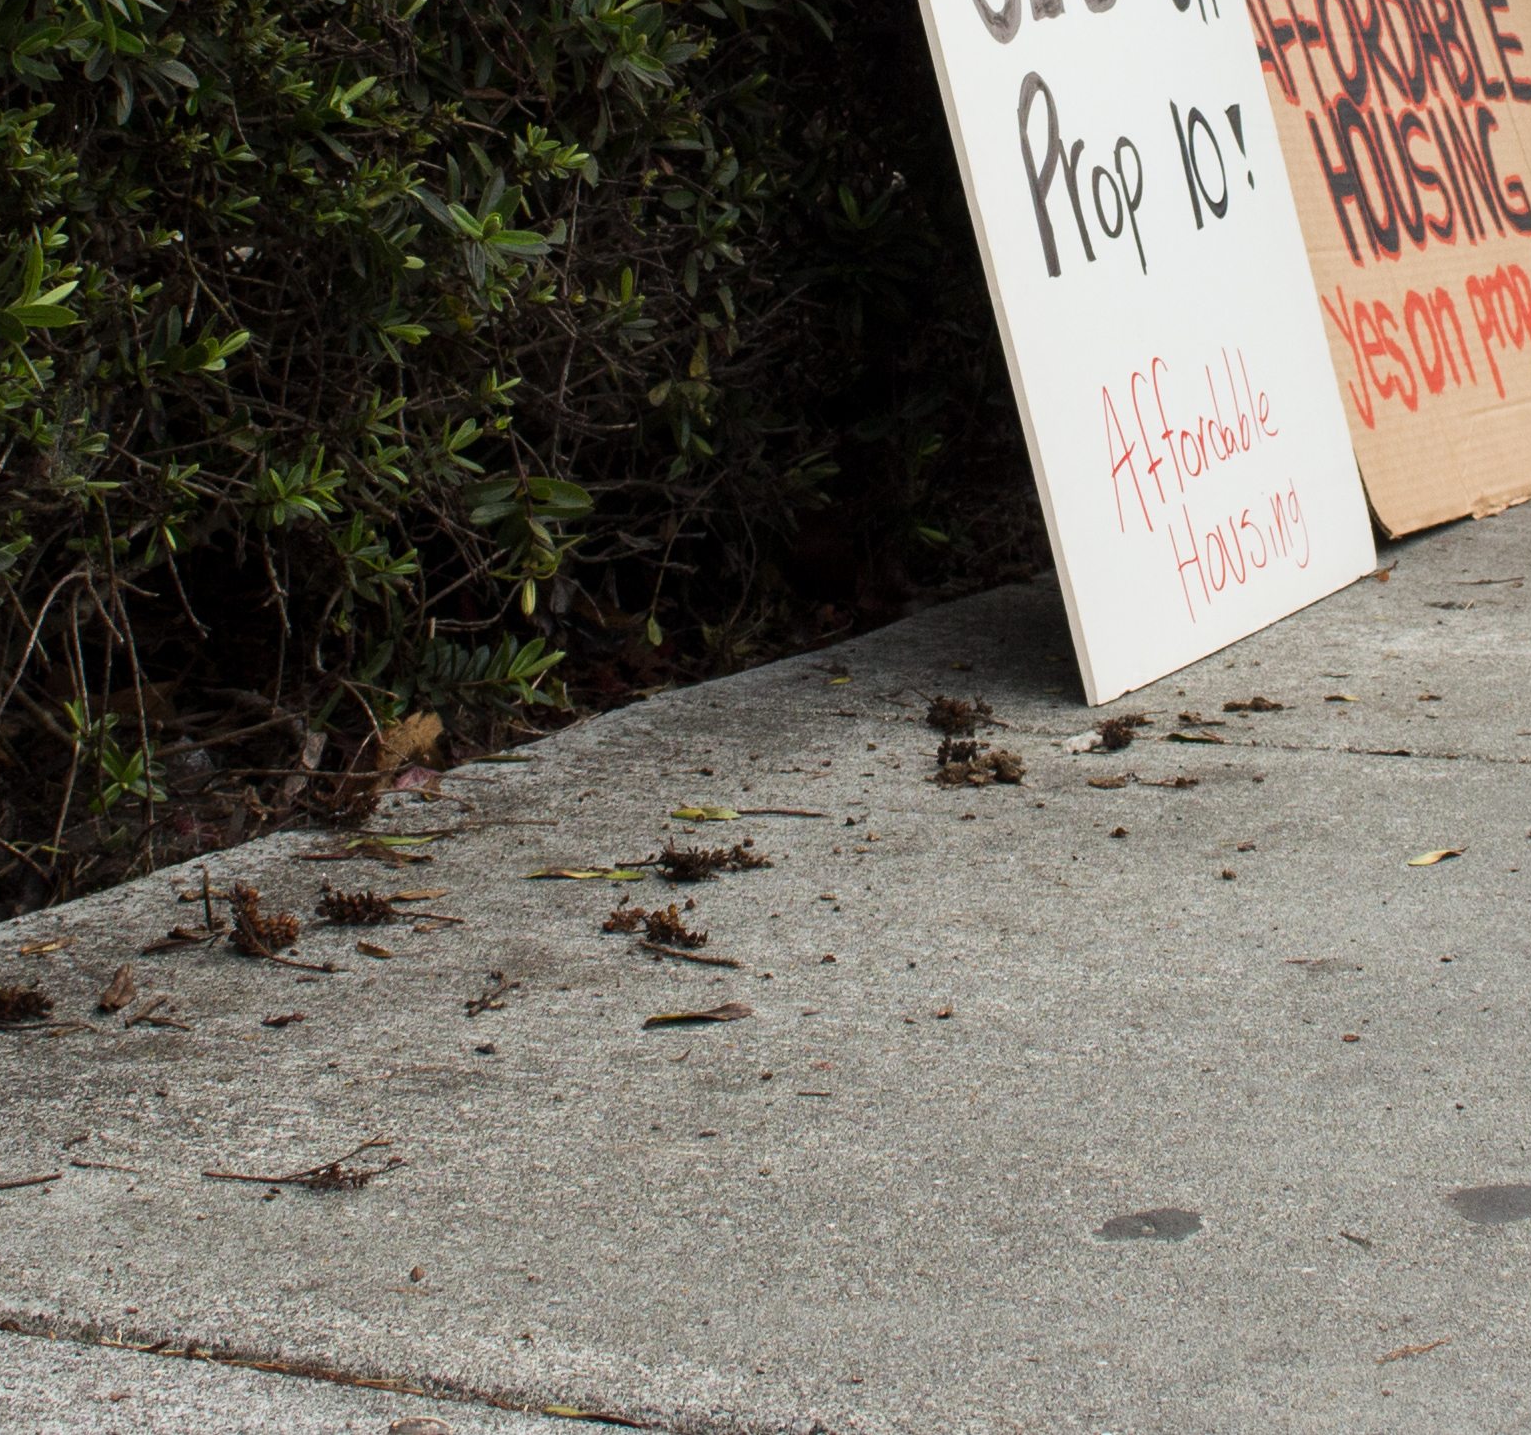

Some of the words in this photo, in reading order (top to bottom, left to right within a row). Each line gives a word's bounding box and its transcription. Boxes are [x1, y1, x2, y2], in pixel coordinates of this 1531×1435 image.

[1017, 71, 1148, 278] Prop
[1169, 99, 1256, 230] 10!
[1403, 287, 1478, 396] on
[1100, 347, 1280, 534] Affordable
[1168, 478, 1311, 624] Housing
